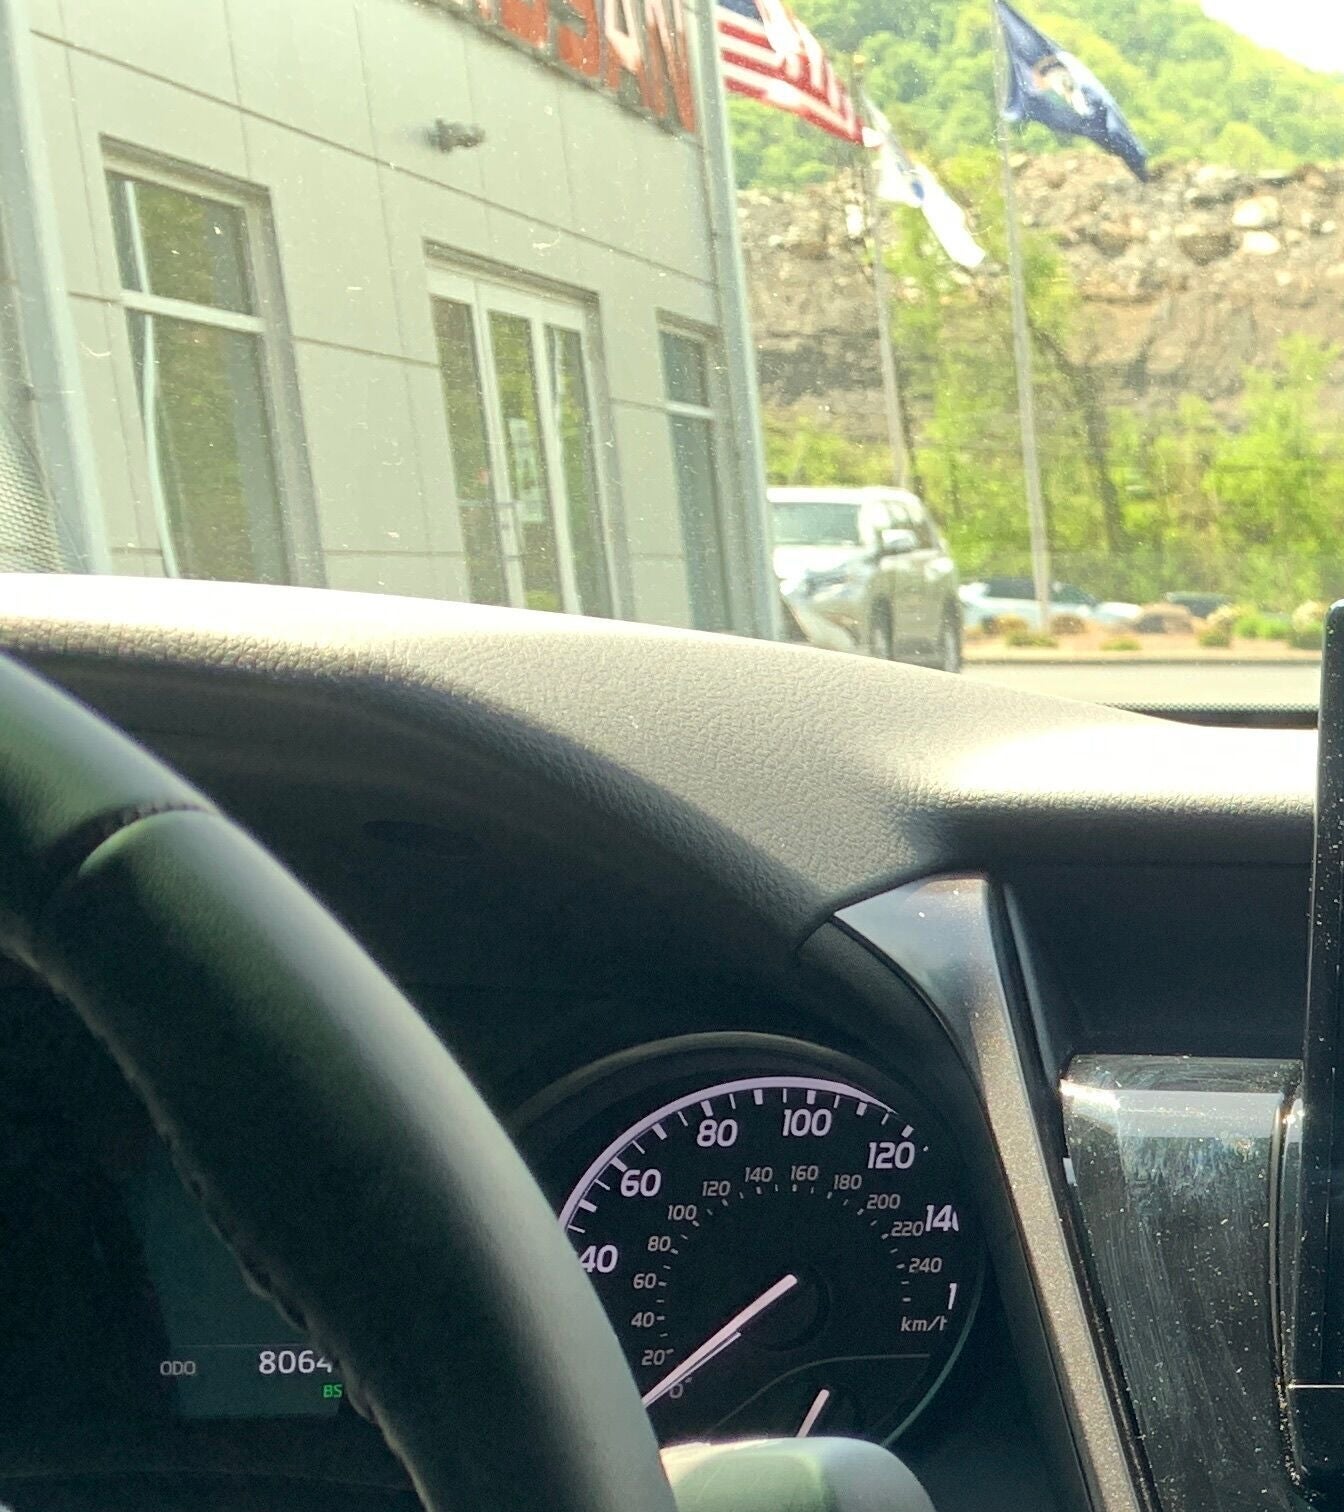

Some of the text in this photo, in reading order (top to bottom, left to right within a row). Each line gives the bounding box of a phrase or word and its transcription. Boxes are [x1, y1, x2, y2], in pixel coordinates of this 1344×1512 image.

[782, 1108, 833, 1138] 100
[696, 1118, 739, 1148] 80
[867, 1141, 916, 1170] 120
[744, 1166, 774, 1183] 140
[790, 1164, 820, 1182] 160
[833, 1173, 863, 1191] 180
[619, 1169, 662, 1198] 60
[702, 1180, 731, 1198] 120
[866, 1193, 901, 1210] 200
[667, 1204, 698, 1222] 100
[891, 1220, 924, 1237] 220
[647, 1236, 671, 1253] 80
[579, 1244, 619, 1274] 40
[908, 1257, 943, 1273] 240
[632, 1273, 657, 1290] 60
[630, 1311, 656, 1328] 40
[641, 1349, 666, 1367] 20
[159, 1360, 197, 1376] ODO
